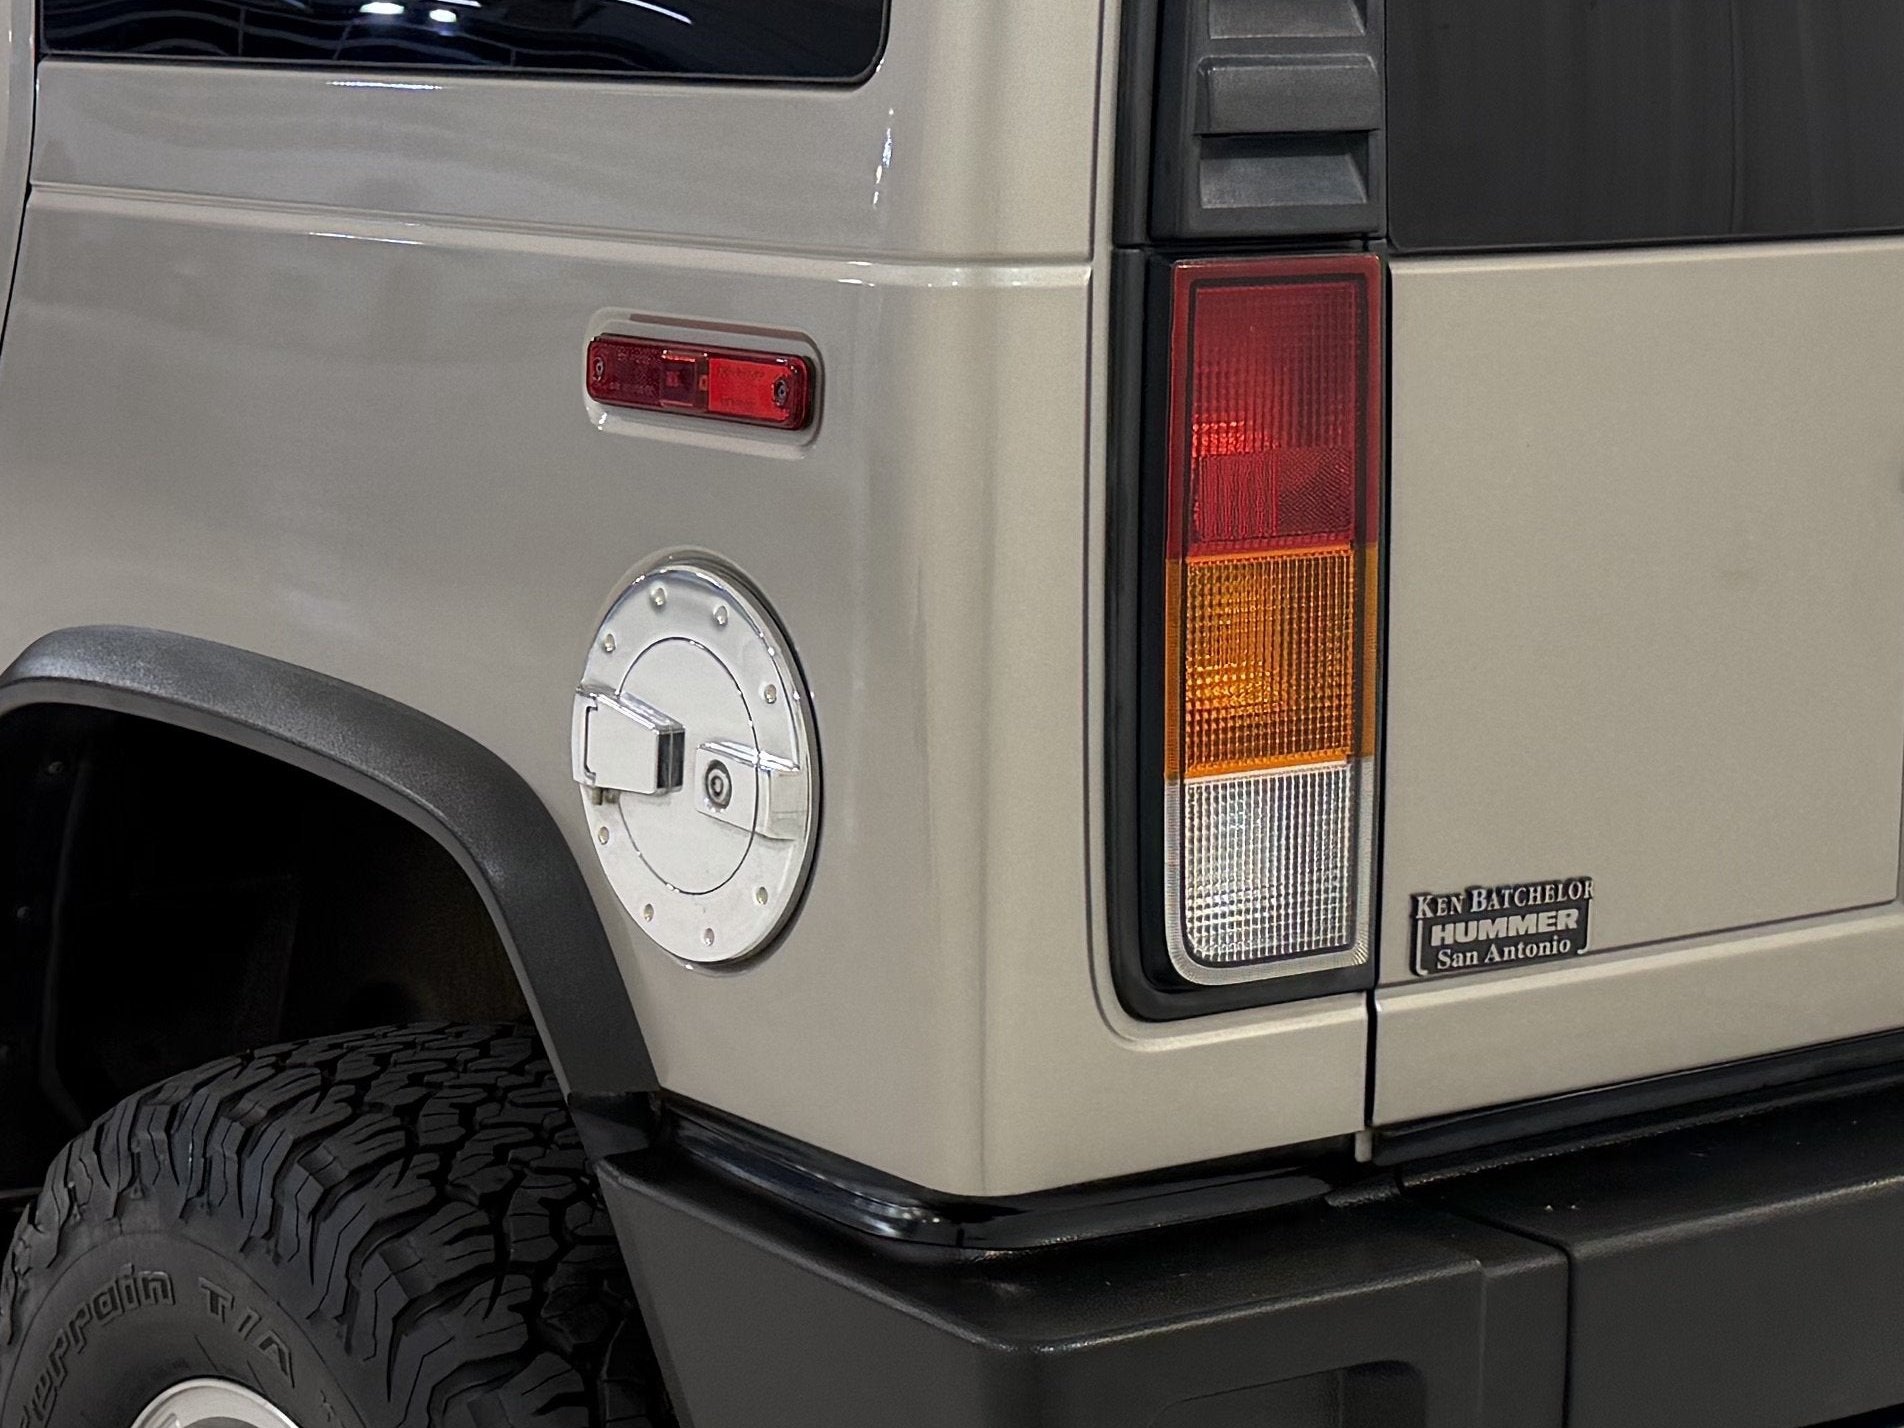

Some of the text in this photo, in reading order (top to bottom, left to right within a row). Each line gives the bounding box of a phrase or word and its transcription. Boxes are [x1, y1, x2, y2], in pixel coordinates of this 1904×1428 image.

[1431, 908, 1579, 947] HUMMER
[1436, 935, 1572, 970] San Antonio
